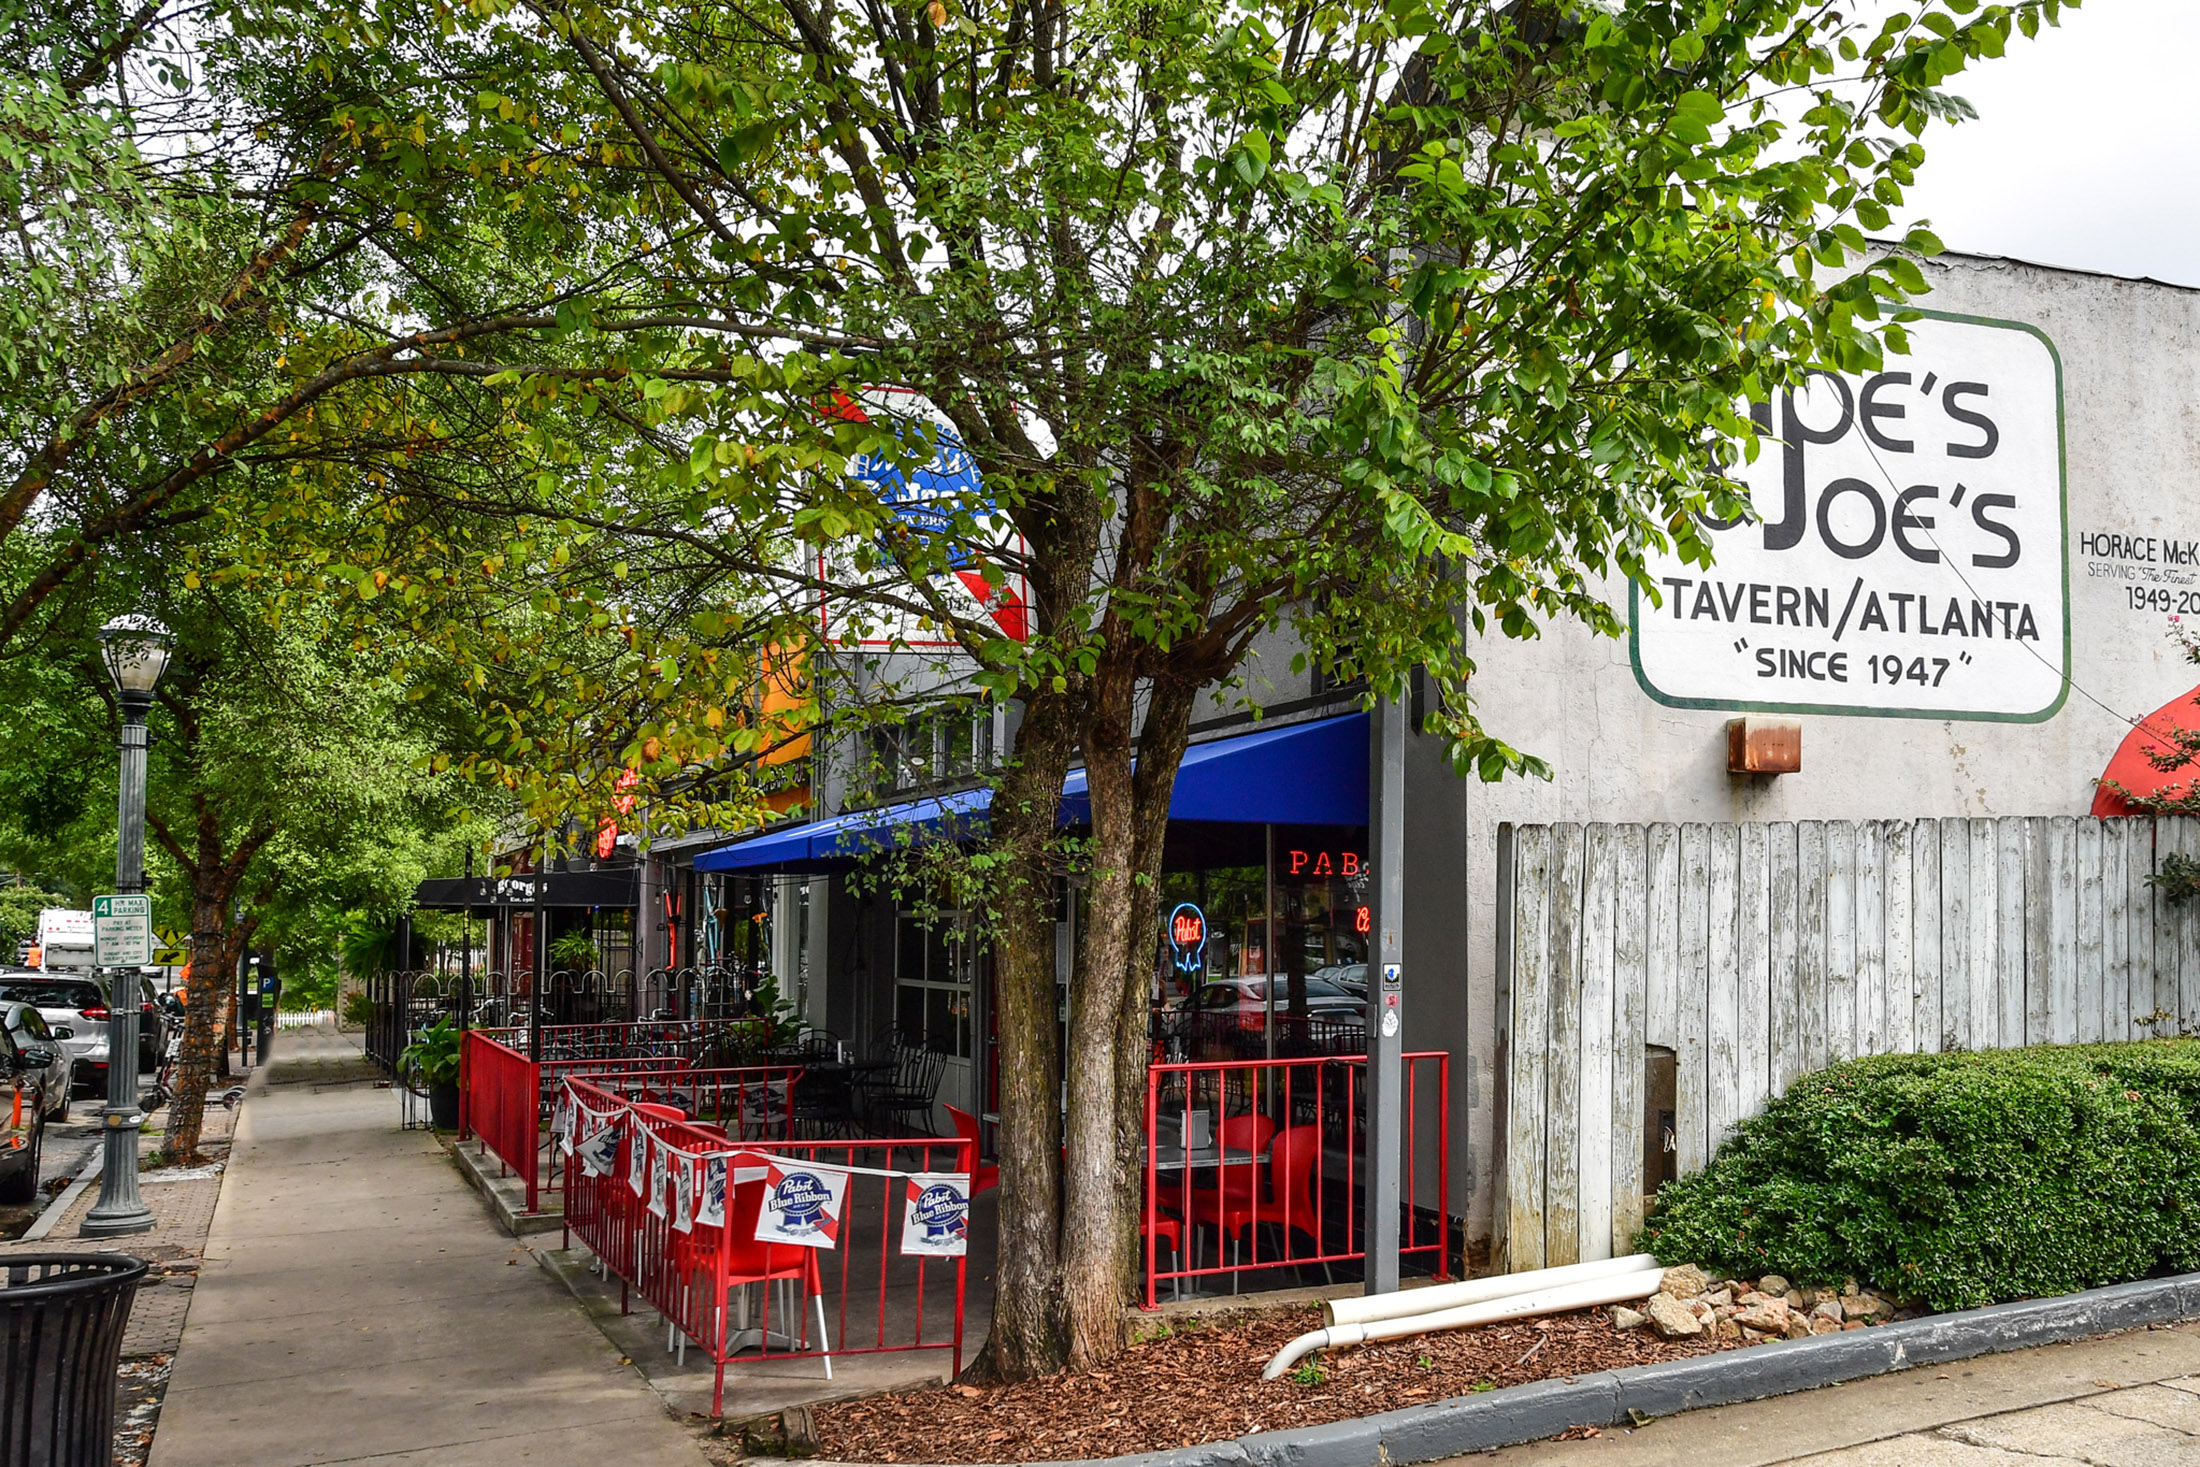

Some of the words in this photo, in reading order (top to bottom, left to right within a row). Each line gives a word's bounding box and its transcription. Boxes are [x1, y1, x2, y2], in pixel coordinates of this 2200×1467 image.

[2081, 532, 2156, 562] HORACE
[2088, 562, 2135, 580] SERVING
[2162, 569, 2198, 585] Finest
[1662, 577, 2041, 641] TAVERN/ATLANTA
[1290, 851, 1370, 875] PAB
[97, 900, 109, 915] 4
[1175, 915, 1201, 942] Pabst
[781, 1179, 814, 1195] Pabst
[770, 1197, 793, 1211] Blue
[794, 1191, 830, 1203] Ribbon
[922, 1190, 951, 1208] Pabst
[913, 1210, 934, 1224] Blue
[934, 1201, 969, 1215] Ribbon
